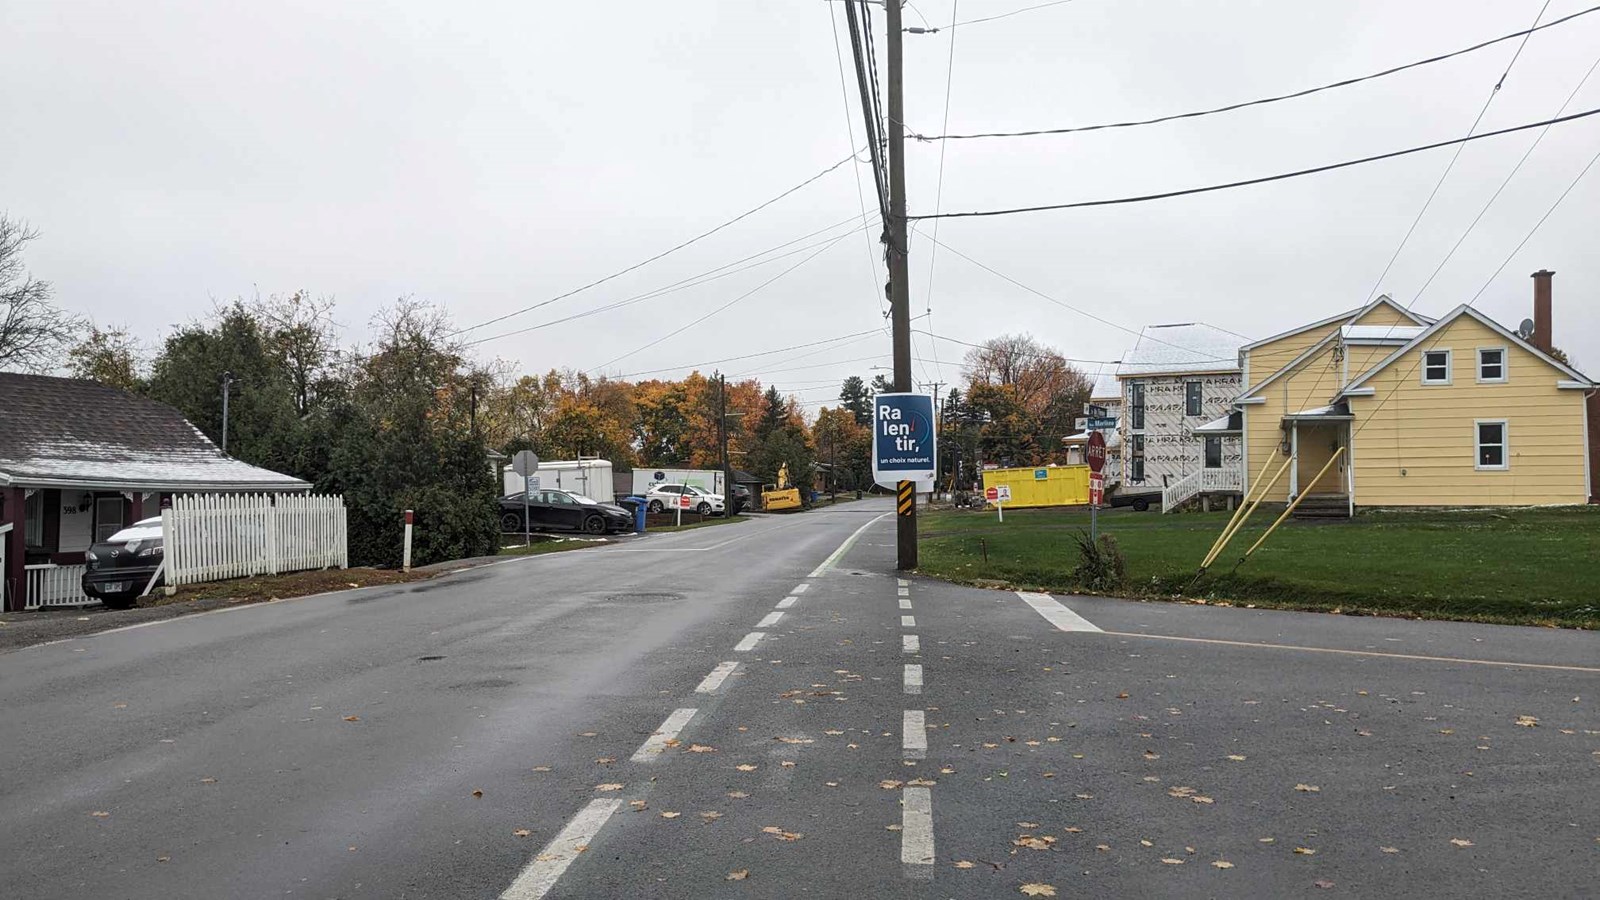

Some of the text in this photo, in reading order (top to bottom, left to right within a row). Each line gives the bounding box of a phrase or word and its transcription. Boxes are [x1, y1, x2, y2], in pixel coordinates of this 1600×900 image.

[880, 405, 901, 420] Ra
[883, 421, 909, 436] len
[895, 435, 919, 453] tir,
[907, 456, 930, 464] naturel.
